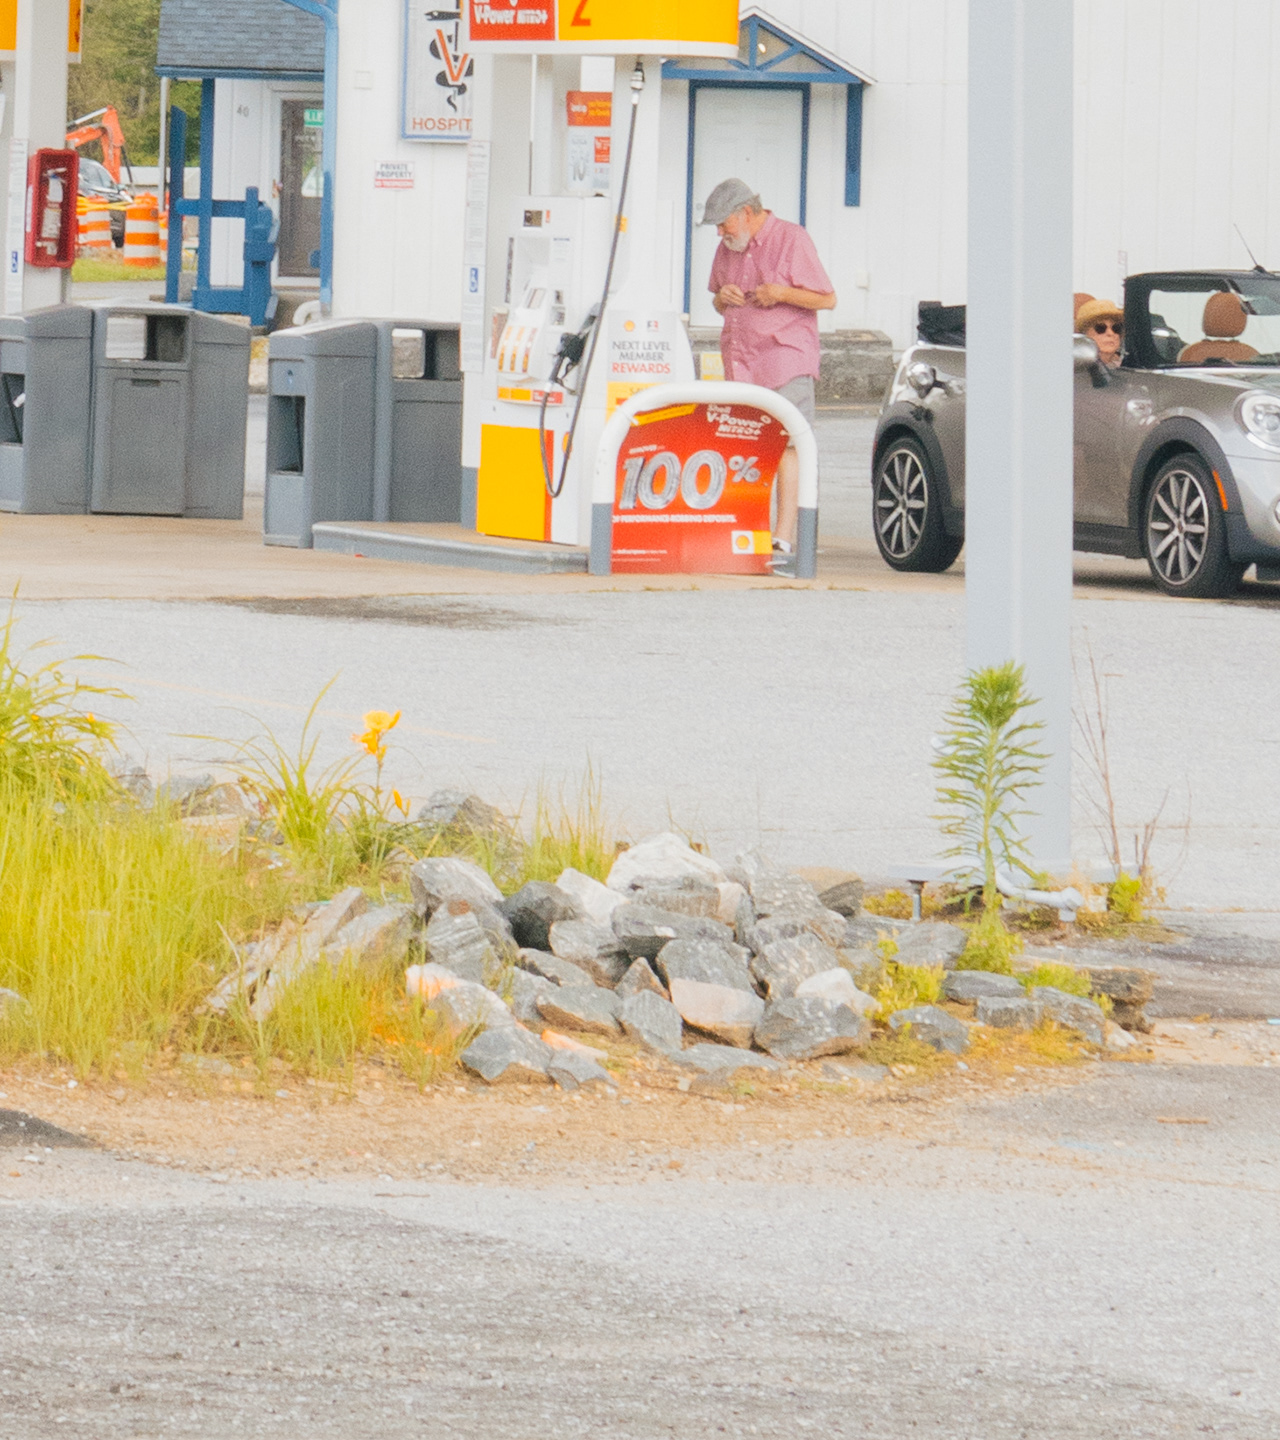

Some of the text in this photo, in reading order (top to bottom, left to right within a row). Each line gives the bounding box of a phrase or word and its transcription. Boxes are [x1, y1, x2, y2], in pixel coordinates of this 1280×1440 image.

[412, 117, 472, 131] HOSPIT
[612, 341, 671, 351] NEXT LEVEL
[619, 351, 664, 361] MEMBER
[612, 362, 671, 374] REWARDS
[706, 411, 764, 428] V-Power
[619, 450, 761, 509] 100%
